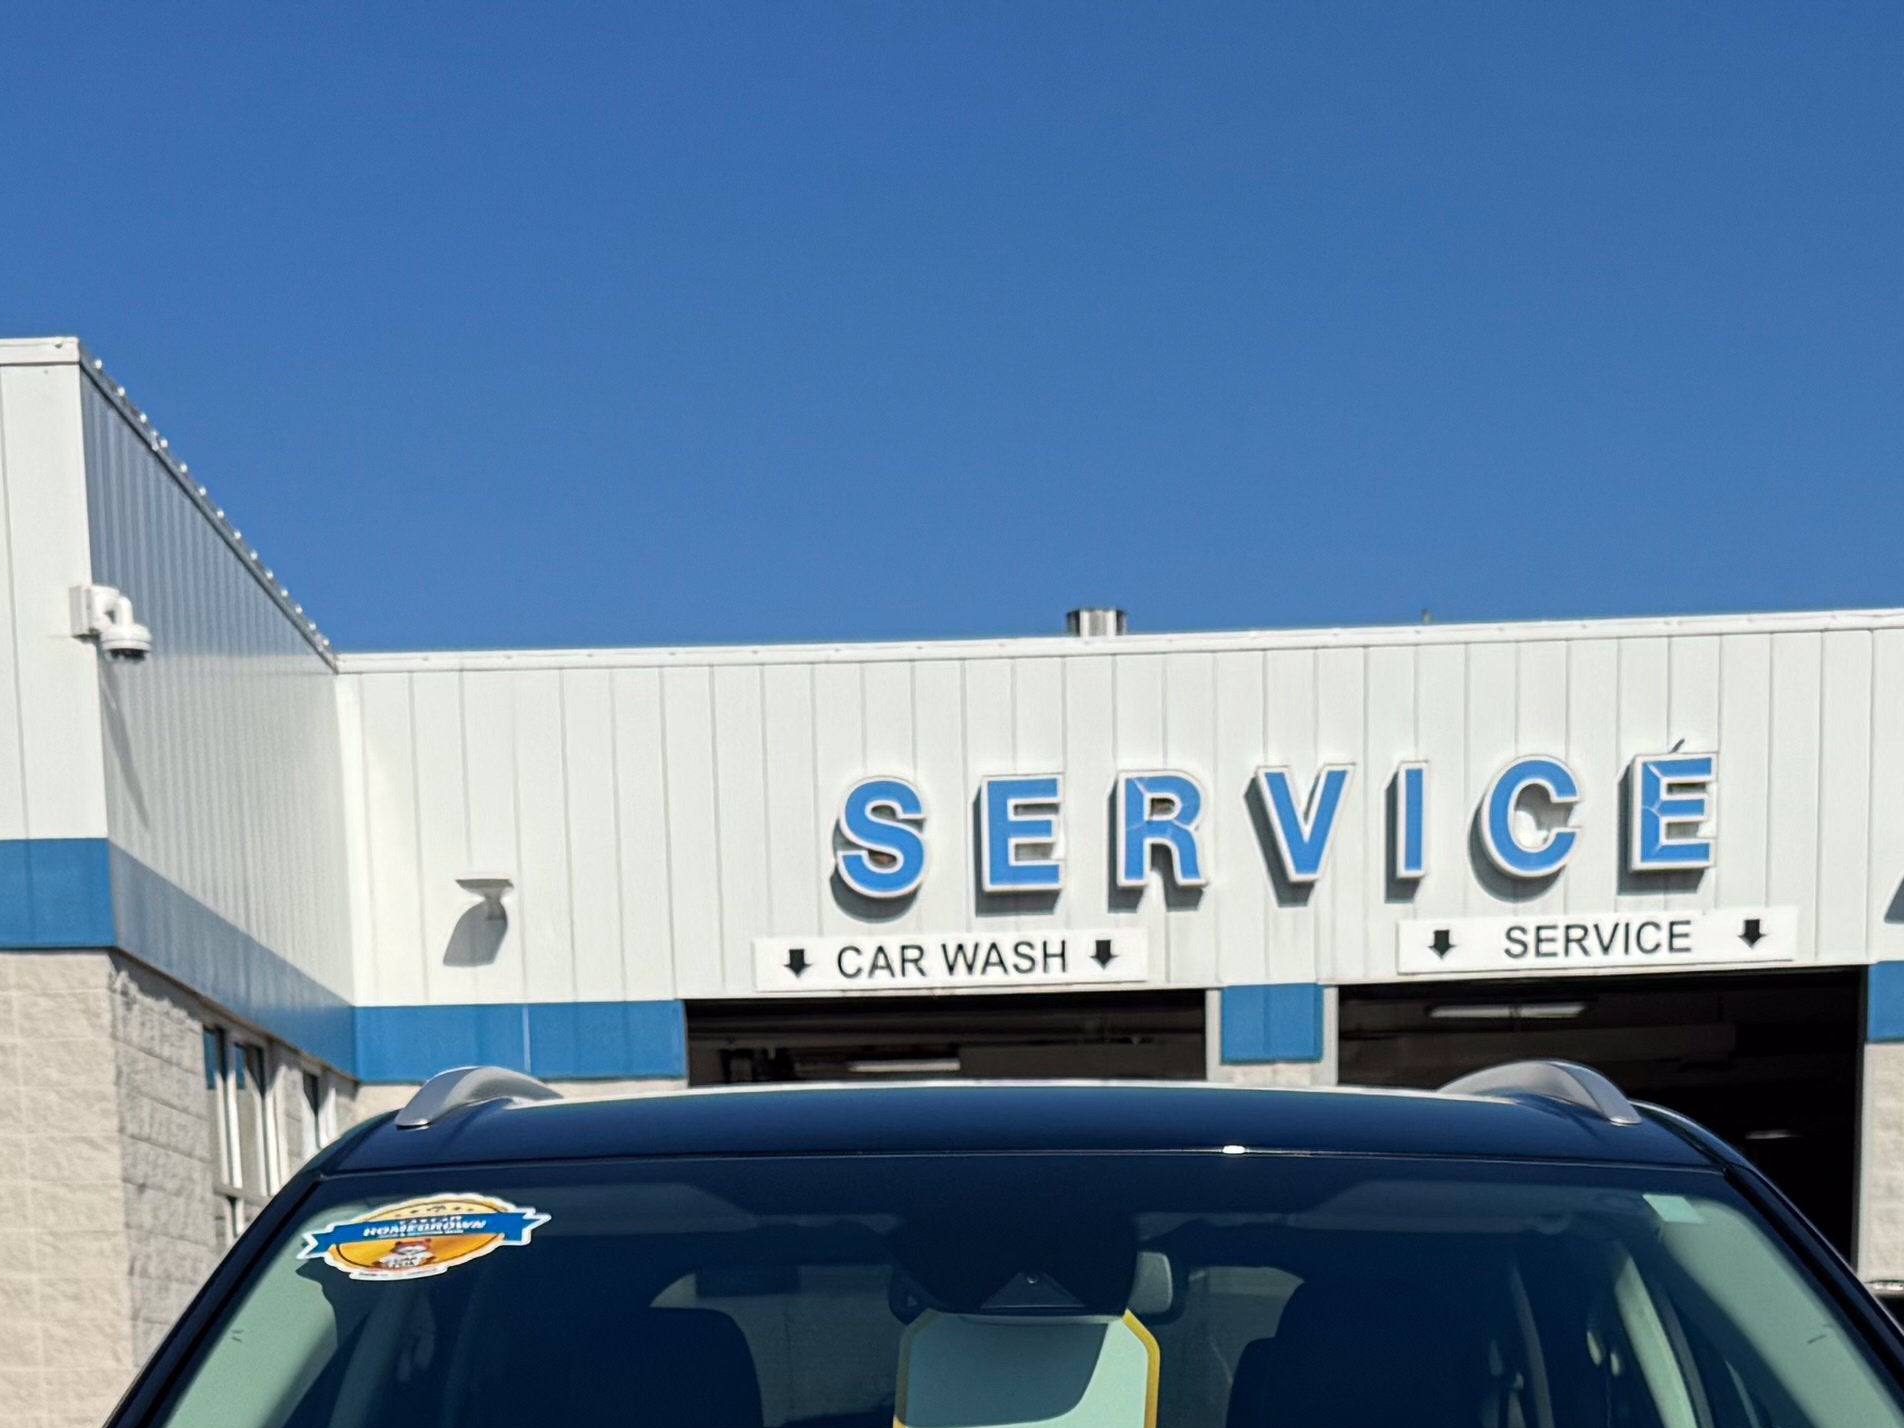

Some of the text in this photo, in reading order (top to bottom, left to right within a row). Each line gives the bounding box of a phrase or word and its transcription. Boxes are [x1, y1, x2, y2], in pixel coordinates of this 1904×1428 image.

[837, 752, 1720, 898] SERVICE
[836, 938, 1069, 980] CAR WASH
[1504, 918, 1694, 960] SERVICE
